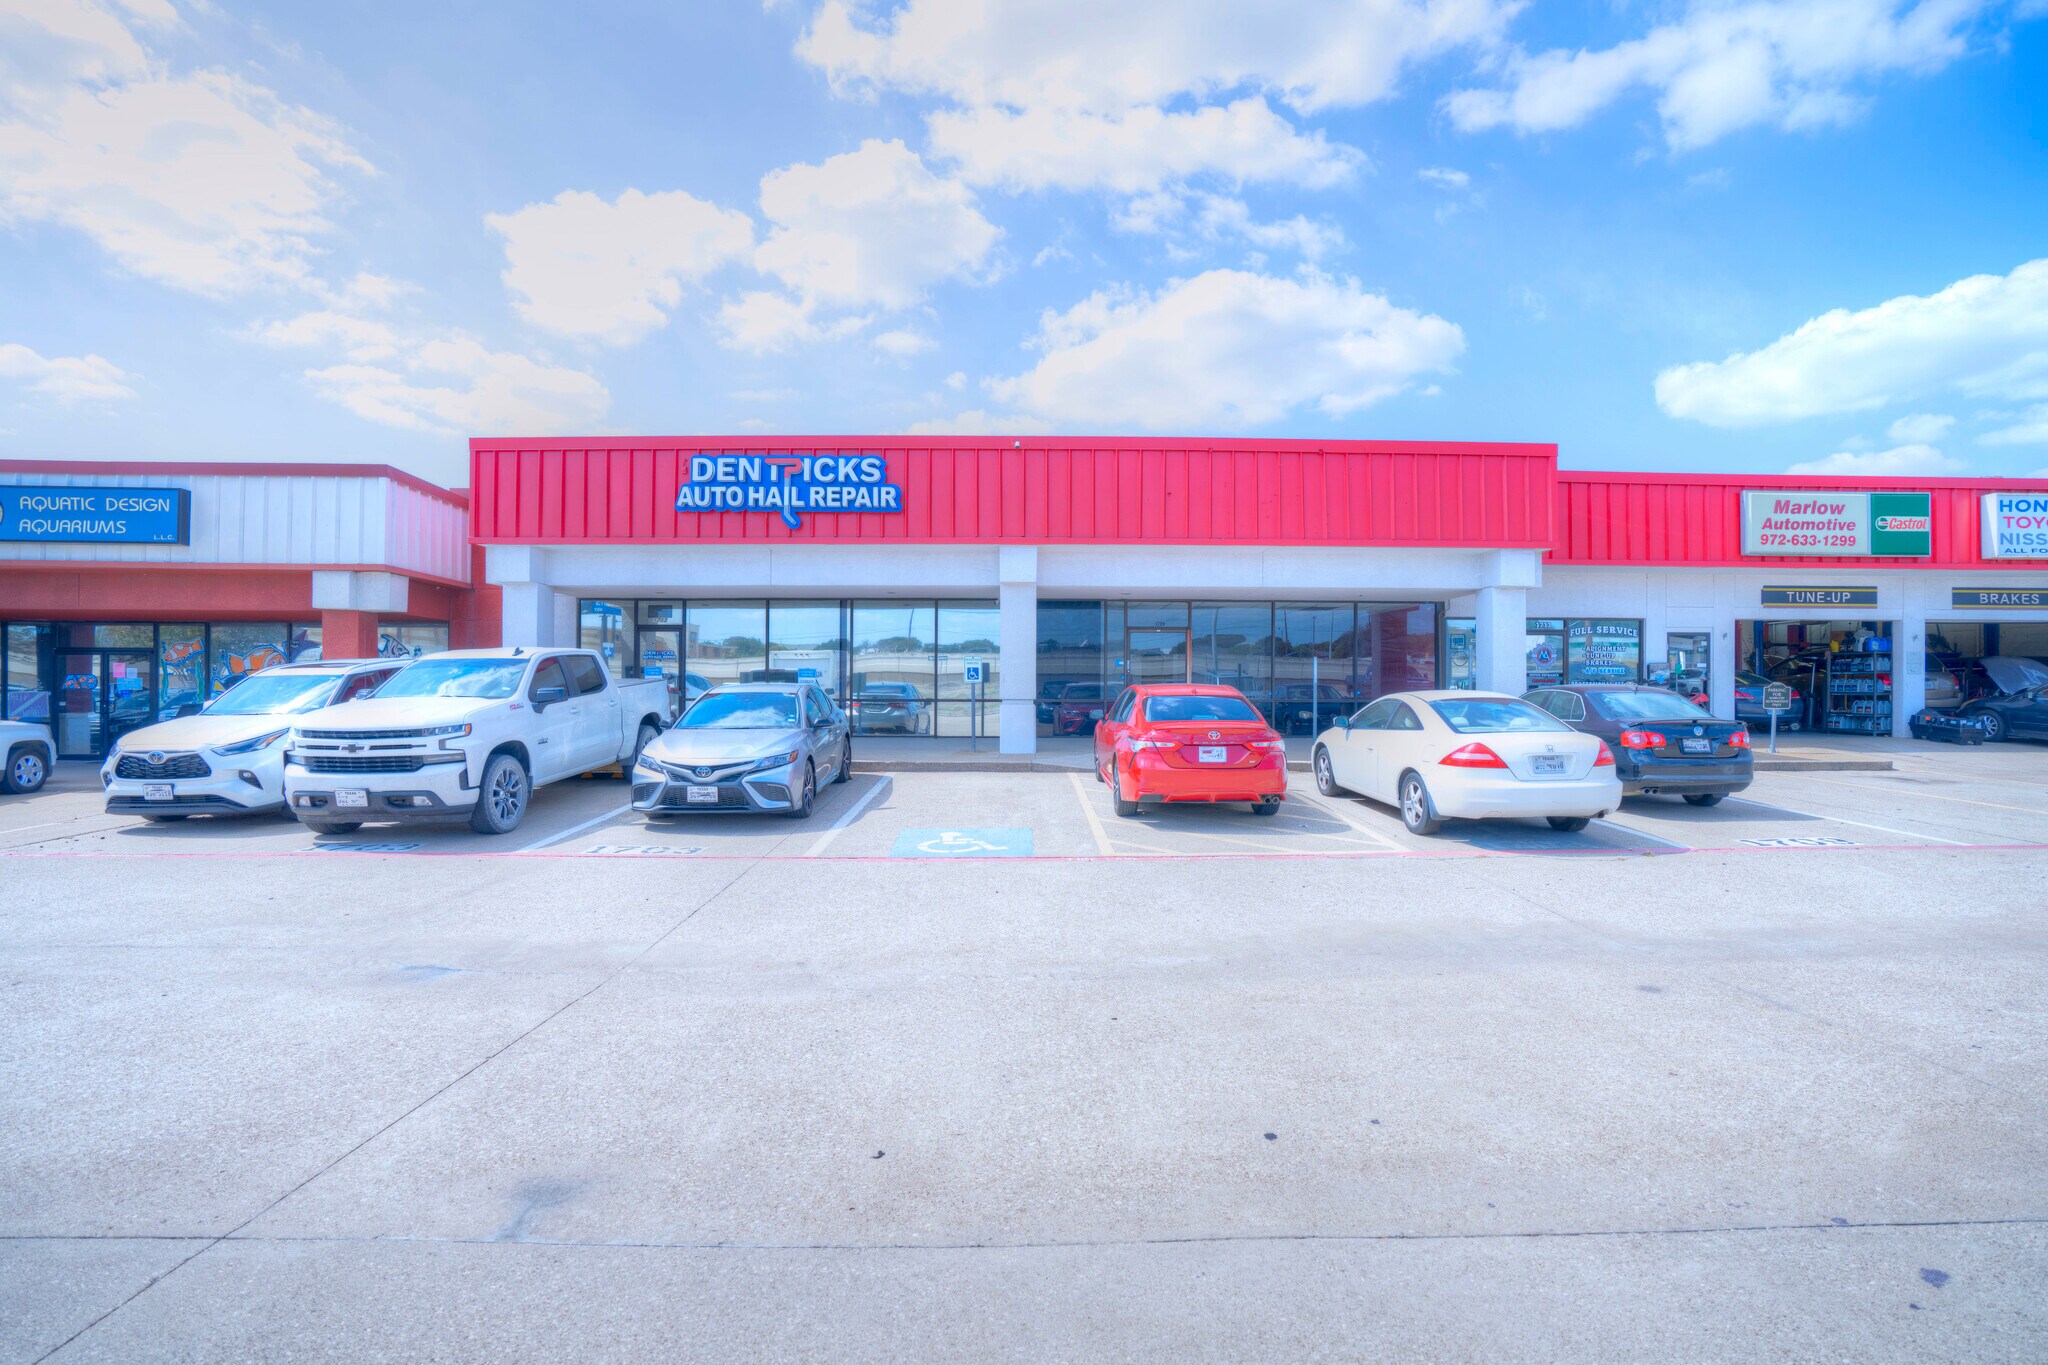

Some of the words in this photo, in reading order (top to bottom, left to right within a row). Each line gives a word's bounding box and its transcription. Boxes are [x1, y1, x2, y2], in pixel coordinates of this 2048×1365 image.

[677, 486, 745, 508] AUTO
[748, 486, 806, 508] HAIL
[810, 486, 899, 508] REPAIR
[18, 495, 96, 513] AQUATIC
[105, 497, 170, 513] DESIGN
[1773, 499, 1846, 515] Marlow
[18, 518, 127, 535] AQUARIUMS
[1761, 517, 1857, 531] Automotive
[1889, 517, 1927, 530] Castrol
[2003, 516, 2048, 529] TOY
[1760, 533, 1857, 547] 972-633-1299
[1786, 591, 1851, 603] TUNE-UP
[1980, 593, 2040, 604] BRAKES
[1570, 627, 1593, 637] FULL
[1596, 626, 1638, 637] SERVICE
[585, 845, 703, 855] 1703
